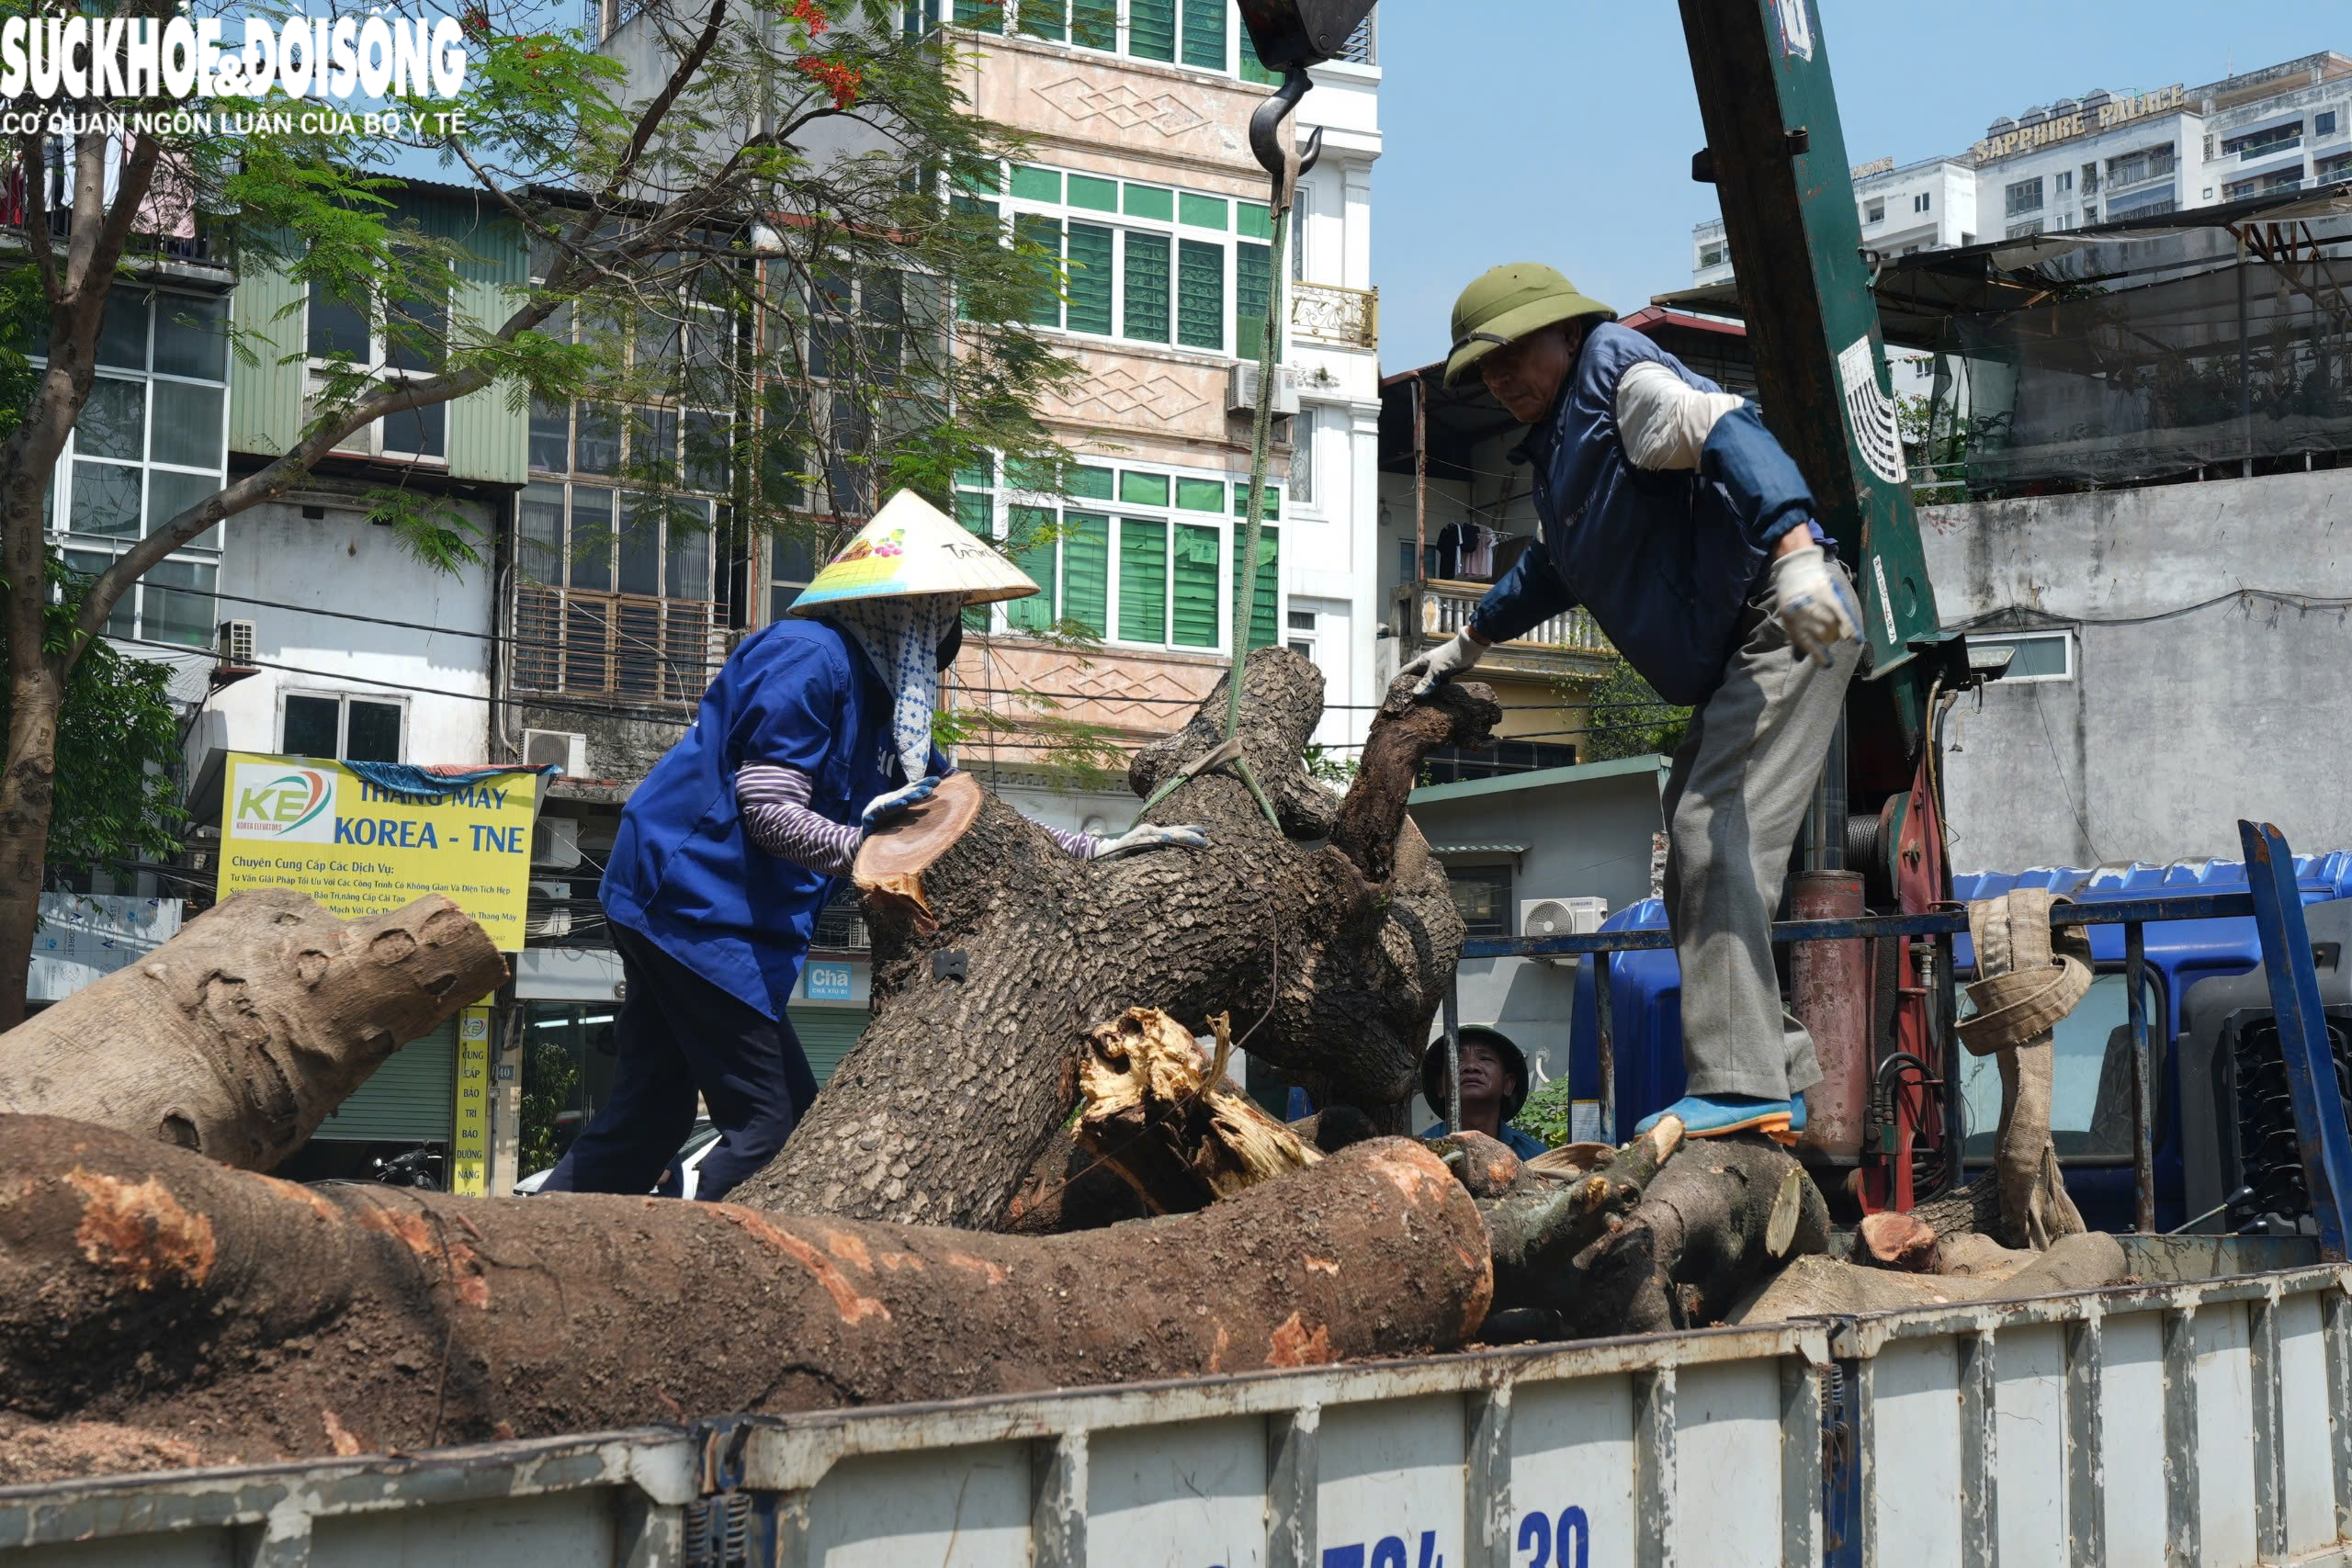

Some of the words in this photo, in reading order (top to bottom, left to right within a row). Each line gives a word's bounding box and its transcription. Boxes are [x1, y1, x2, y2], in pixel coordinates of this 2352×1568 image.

[1975, 111, 2086, 163] SAPPHIRE
[2098, 83, 2184, 128] PALACE
[452, 781, 508, 809] MÁY
[237, 787, 309, 822] KE
[334, 817, 438, 850] KOREA
[469, 824, 525, 853] TNE
[232, 855, 272, 870] Chuyên
[275, 858, 302, 872] Cung
[306, 859, 326, 873] Cấp
[329, 860, 348, 872] Các
[352, 862, 375, 874] Dịch
[378, 863, 394, 876] Vụ:
[392, 894, 406, 903] Tạo
[478, 912, 500, 921] Thang
[462, 1051, 484, 1060] CUNG
[465, 1066, 481, 1078] CẤP
[499, 1067, 510, 1077] 40
[463, 1086, 480, 1098] BẢO
[462, 1127, 478, 1138] BẢO
[457, 1148, 482, 1159] DƯỠNG
[458, 1168, 480, 1179] NÂNG
